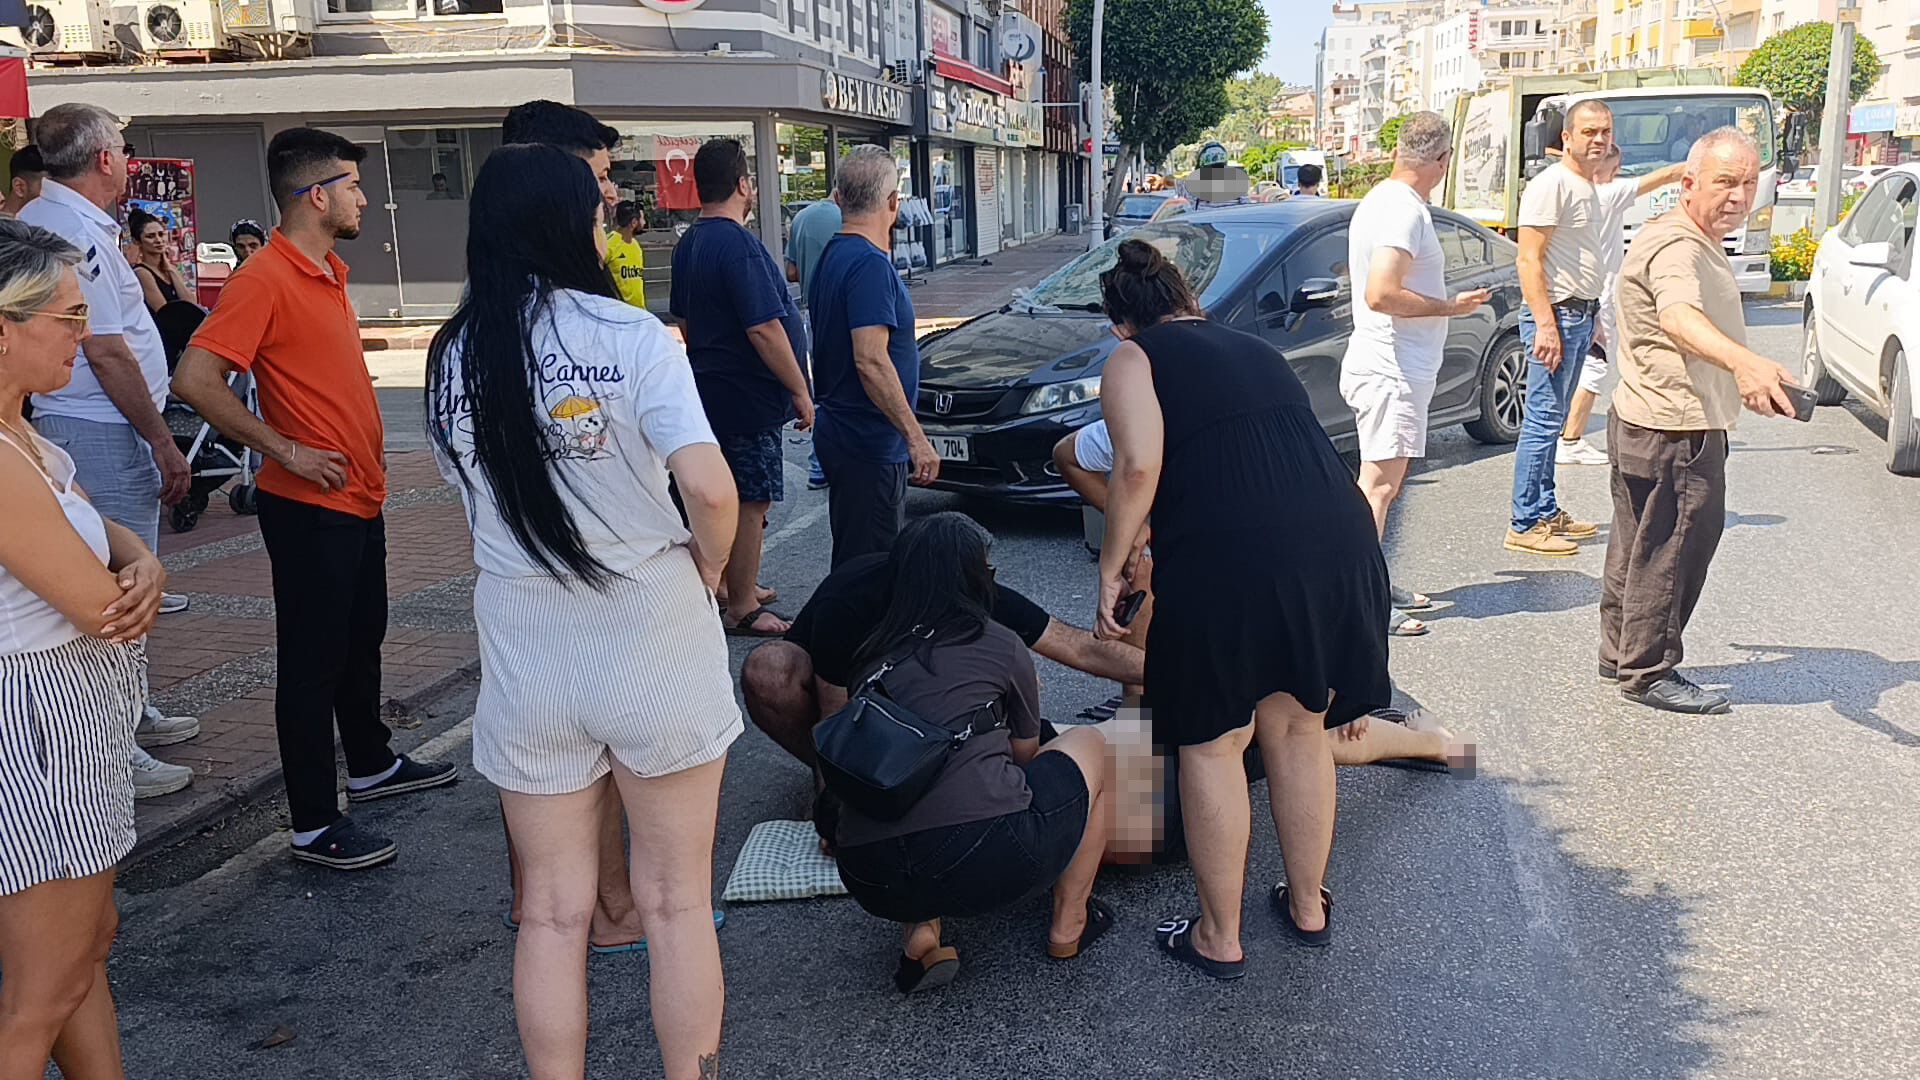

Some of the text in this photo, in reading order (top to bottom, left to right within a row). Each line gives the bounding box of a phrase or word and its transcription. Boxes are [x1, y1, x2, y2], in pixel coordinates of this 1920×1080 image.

[1468, 9, 1478, 50] VESTEL
[838, 75, 904, 120] BEY KASAP
[541, 353, 625, 383] Cannes
[943, 439, 965, 458] 704
